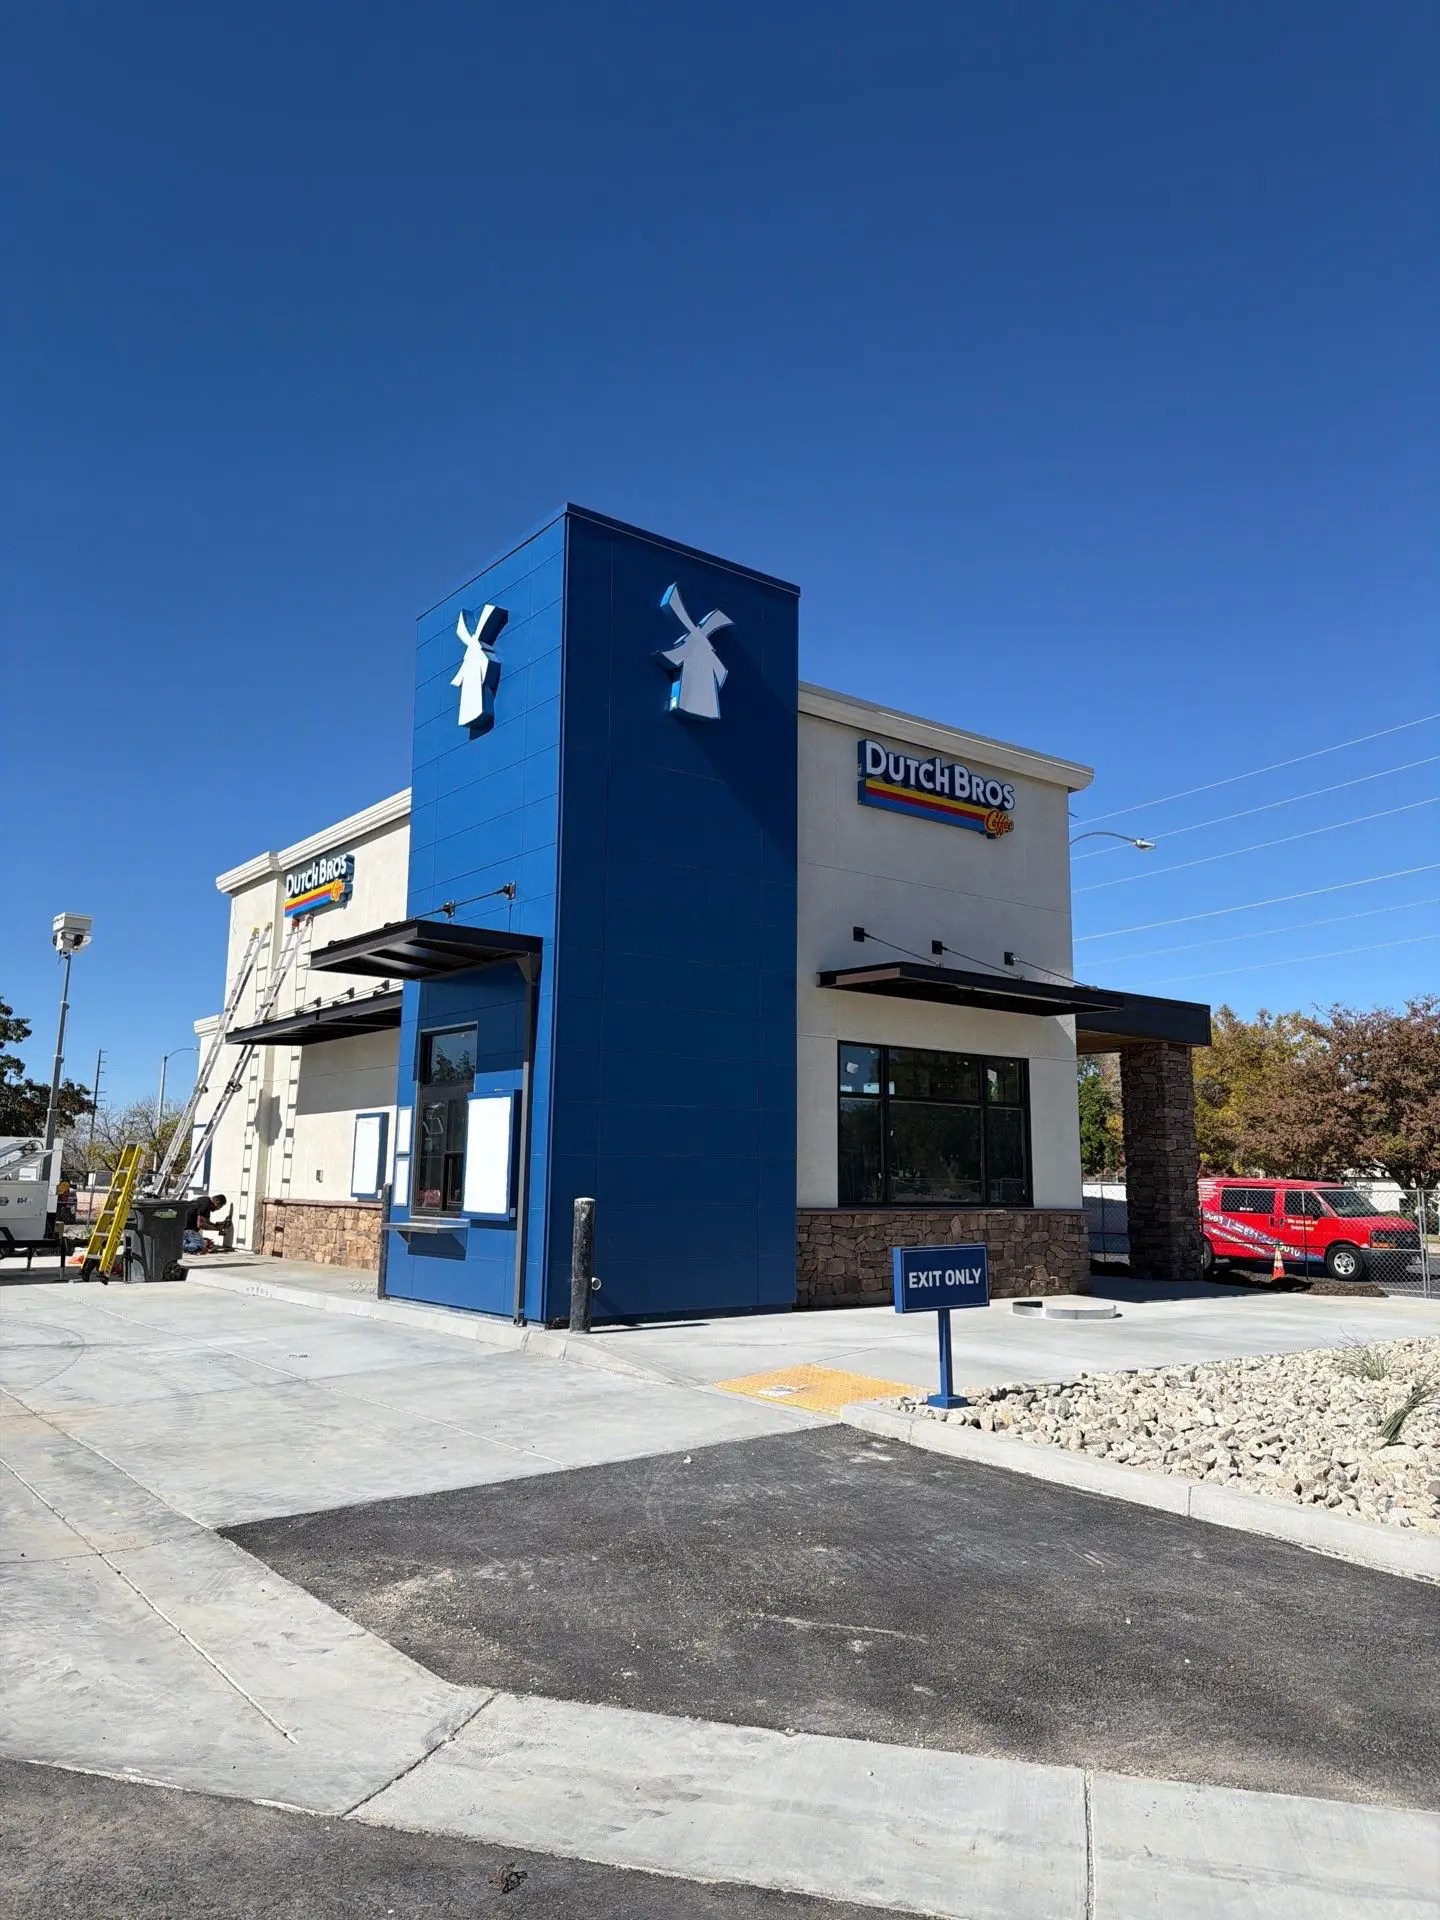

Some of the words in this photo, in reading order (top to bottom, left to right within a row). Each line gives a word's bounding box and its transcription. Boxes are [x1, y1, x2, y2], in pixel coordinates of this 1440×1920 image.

[955, 764, 1015, 810] BROS
[320, 854, 347, 884] BROS
[909, 1271, 942, 1288] EXIT
[945, 1268, 982, 1286] ONLY
